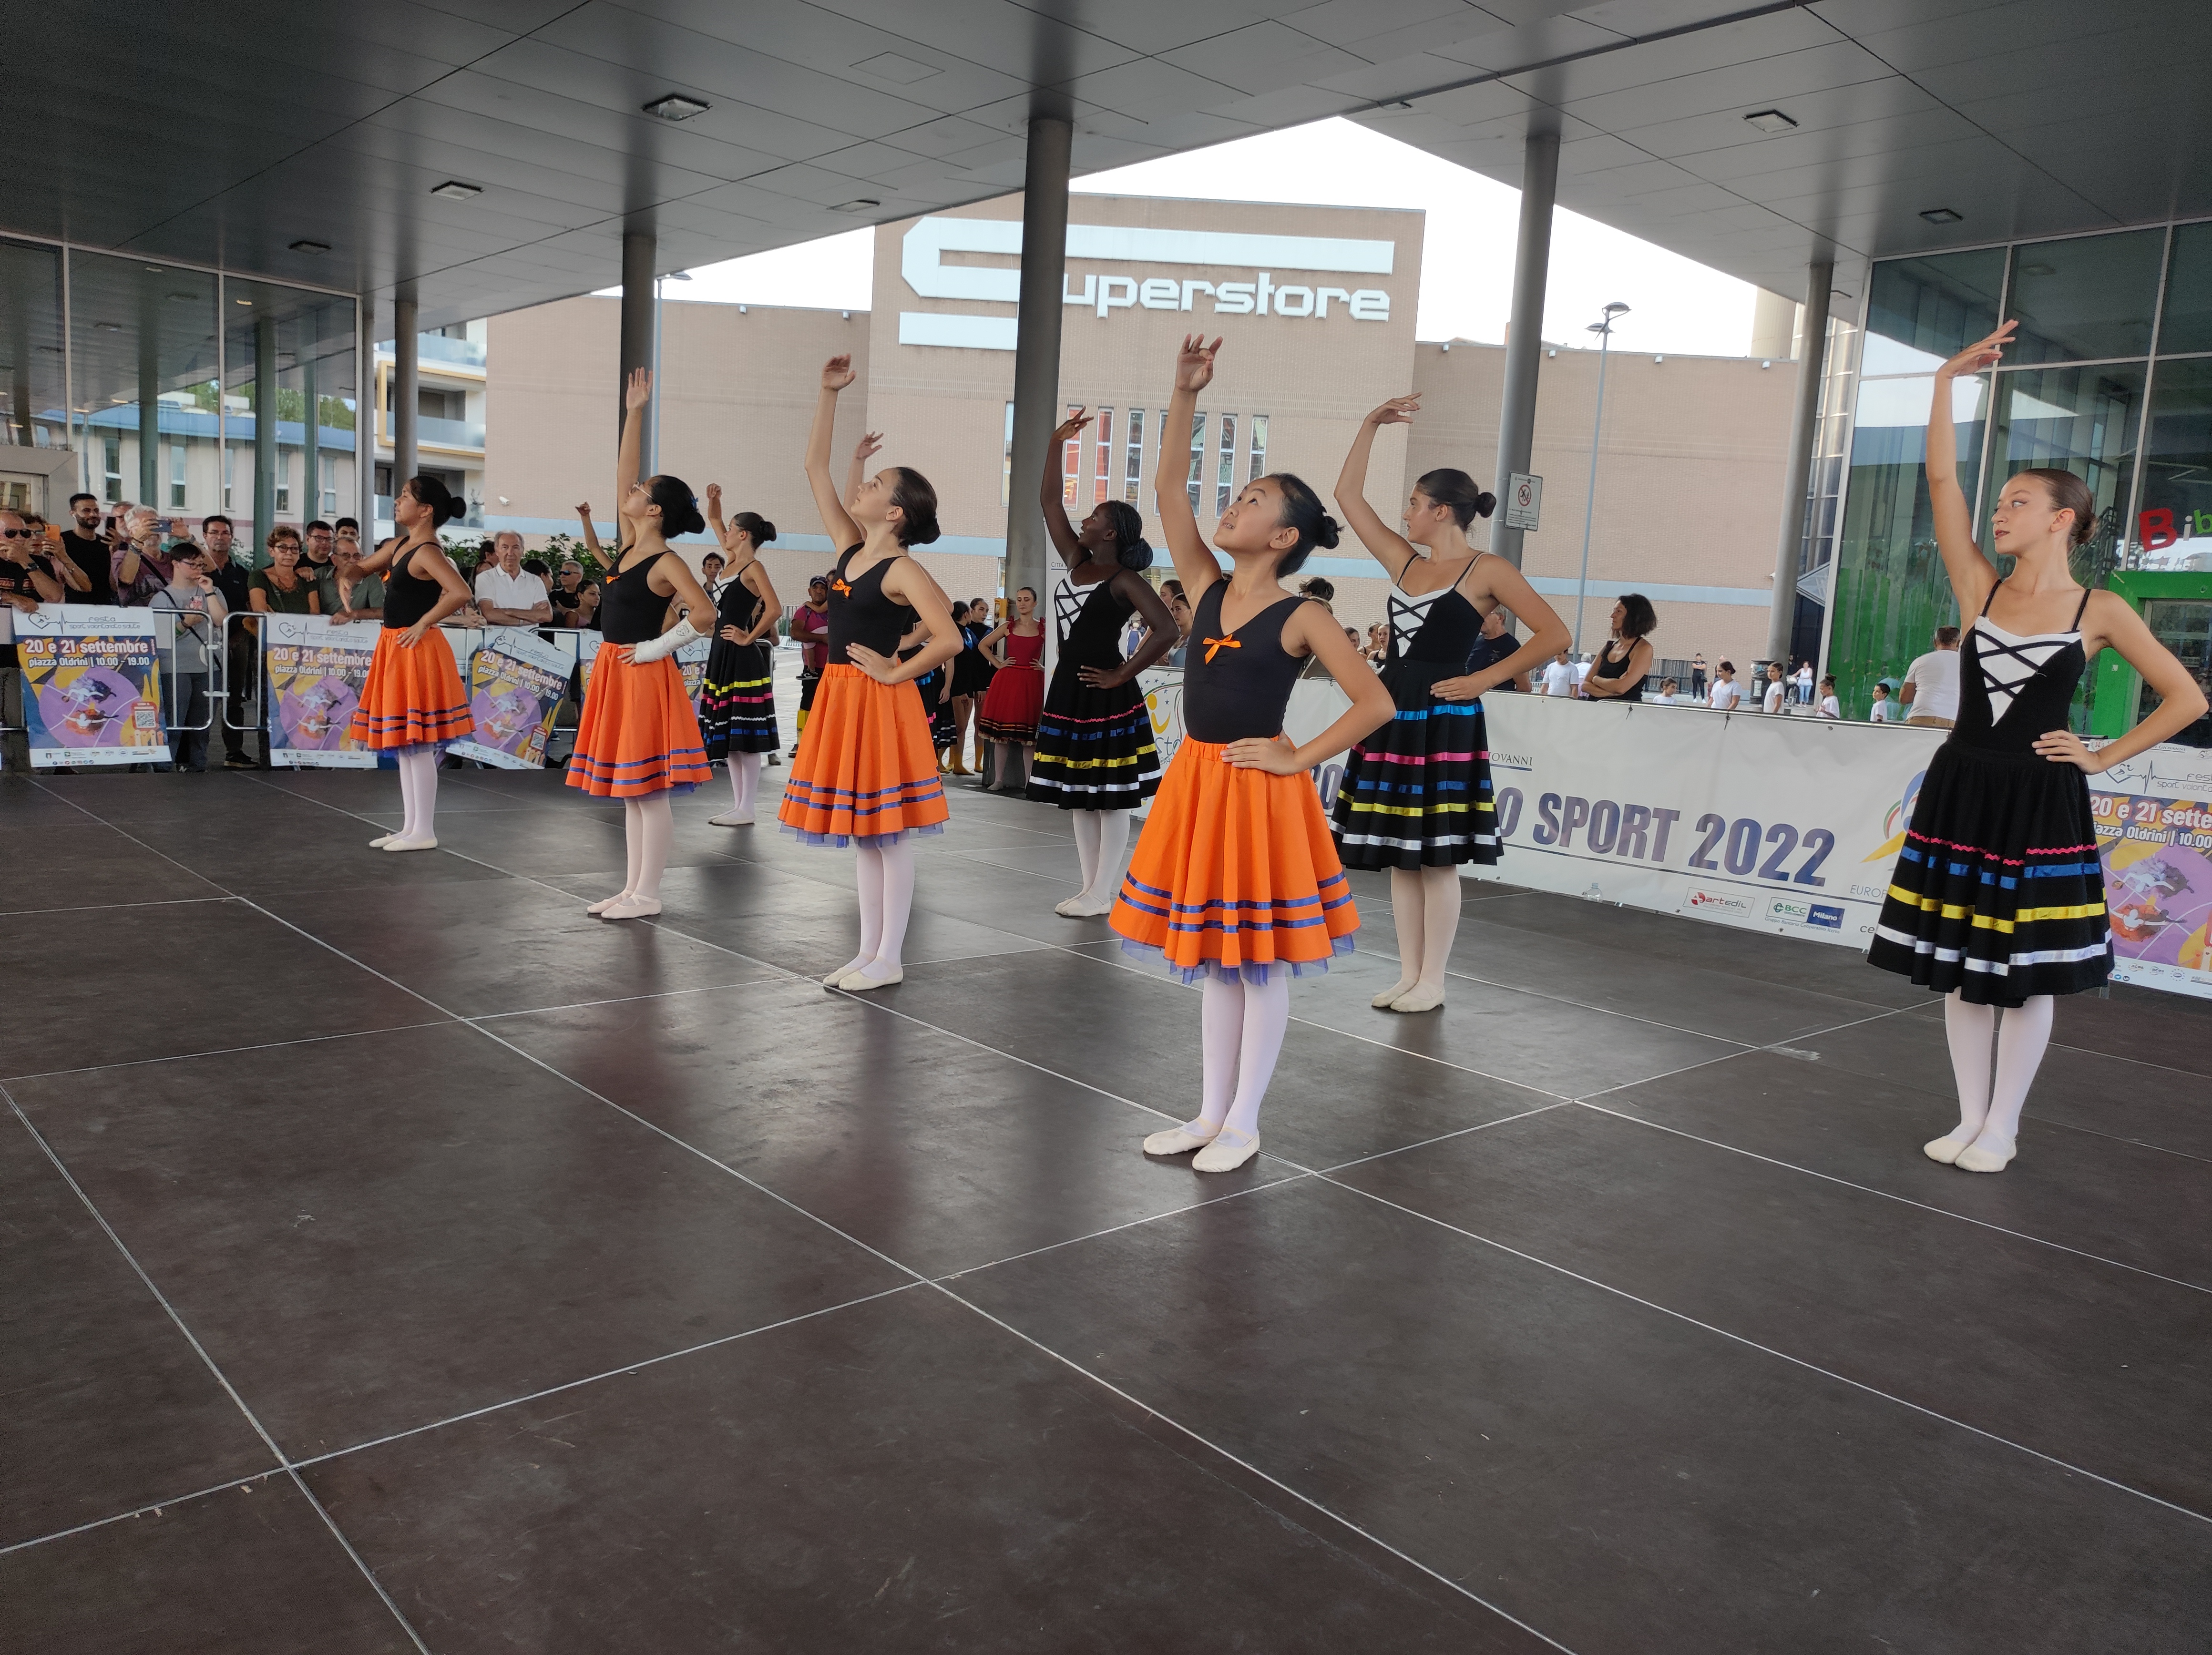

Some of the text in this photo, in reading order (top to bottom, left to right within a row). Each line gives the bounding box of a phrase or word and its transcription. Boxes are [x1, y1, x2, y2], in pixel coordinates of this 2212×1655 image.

[898, 216, 1395, 350] Superstore
[25, 639, 149, 654] 20 e 21 settembre
[29, 657, 57, 667] piazza
[59, 656, 88, 666] Oldrini
[95, 657, 118, 666] 10.00
[127, 656, 150, 666] 19.00
[274, 647, 372, 666] 20 e 21 settembre
[275, 664, 297, 674] piazza
[299, 666, 322, 675] Oldrini
[328, 667, 346, 677] 10.00
[481, 650, 496, 664] 20
[497, 658, 504, 667] e
[505, 659, 517, 672] 21
[518, 665, 563, 690] settembre
[478, 665, 499, 677] piazza
[524, 681, 540, 693] 10.00
[545, 689, 559, 701] 19.00
[2157, 781, 2180, 789] sport
[2090, 796, 2113, 816] 20
[2118, 804, 2130, 818] e
[2135, 802, 2157, 822] 21
[1533, 792, 1680, 863] SPORT
[1688, 813, 1835, 887] 2022
[2093, 822, 2123, 837] iazza
[2127, 826, 2168, 843] Oldrini
[2179, 832, 2212, 848] 10.00
[1784, 904, 1807, 914] BCC
[1813, 911, 1838, 921] Milano
